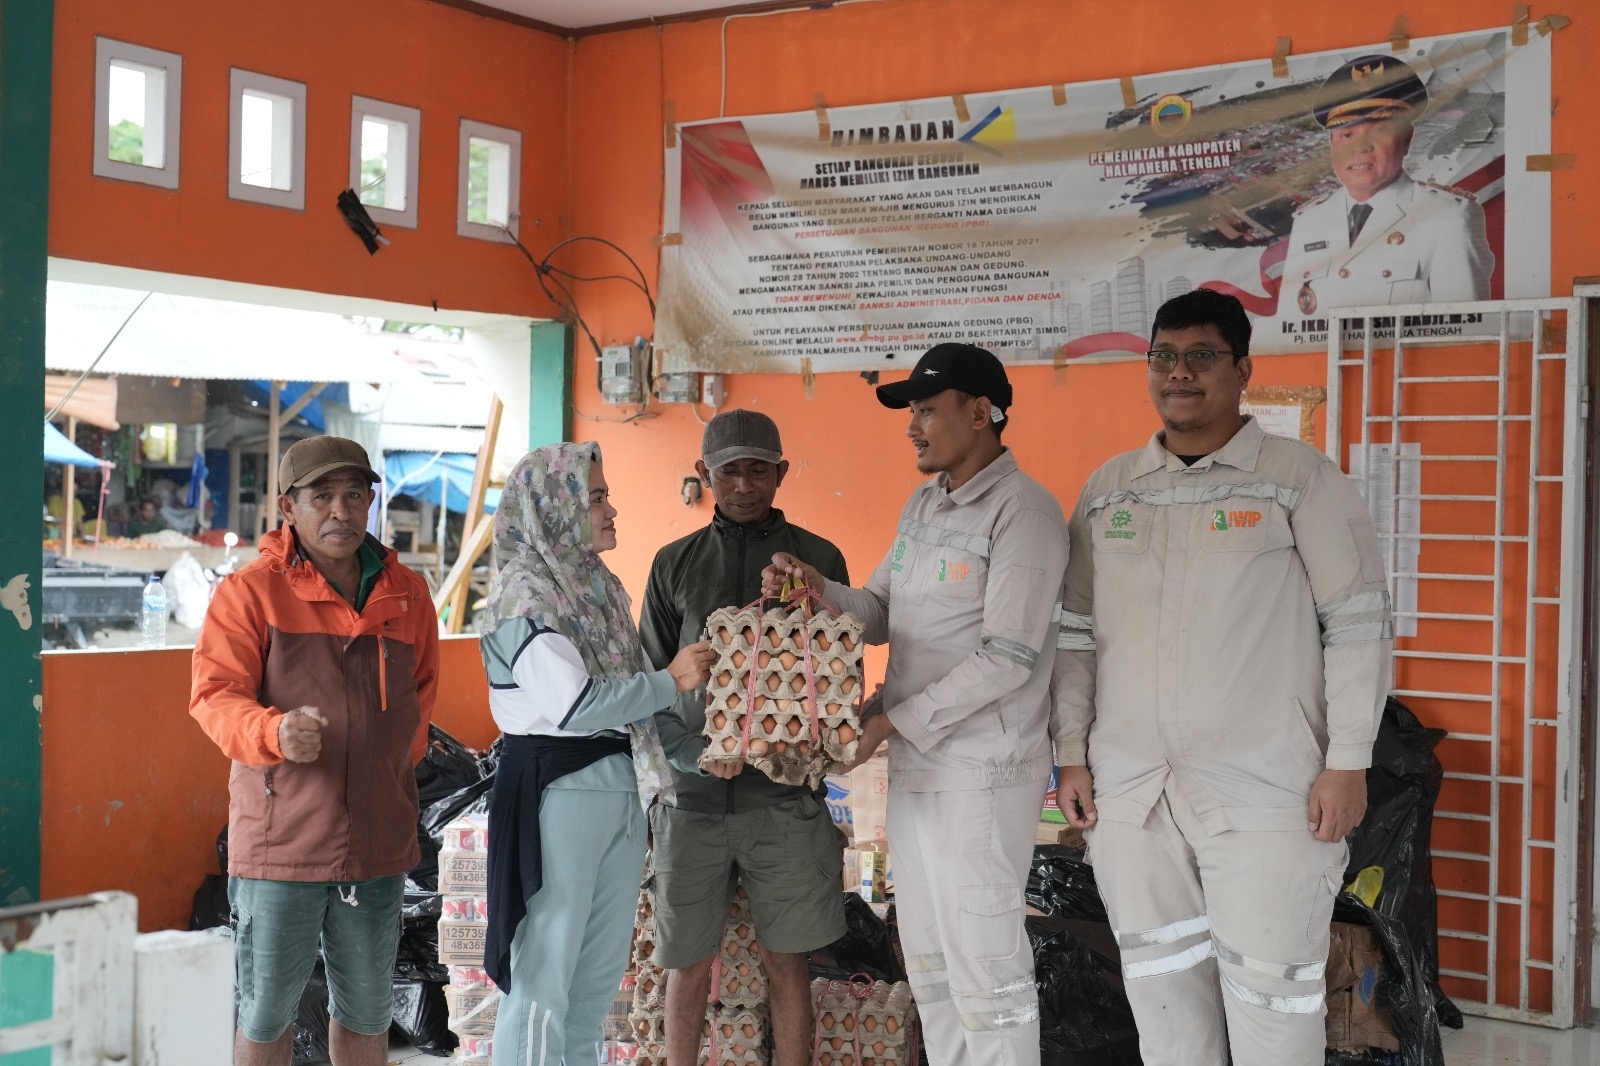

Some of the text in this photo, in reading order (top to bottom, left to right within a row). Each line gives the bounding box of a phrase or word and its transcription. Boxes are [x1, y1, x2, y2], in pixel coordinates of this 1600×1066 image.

[830, 119, 955, 148] HIMBAUAN
[815, 151, 965, 175] SETIAP BANGUNAN GEDUNG
[1090, 138, 1241, 165] PEMERINTAH KABUPATEN
[800, 162, 980, 190] HARUS MEMILIKI IZIN BANGUNAN
[1105, 154, 1230, 178] HALMAHERA TENGAH
[738, 180, 1053, 211] KEPADA SELURUH MASYARAKAT YANG AKAN DAN TELAH MEMBANGUN
[748, 193, 1041, 221] BELUM MEMILIKI IZIN MAKA WAJIB MENGURUS IZIN MENDIRIKAN
[752, 205, 1037, 231] BANGUNAN YANG SEKARANG TELAH BERGANTI NAMA DENGAN
[795, 228, 856, 239] PERSETUJUAN
[858, 224, 911, 236] BANGUNAN
[916, 221, 959, 230] GEDUNG
[748, 238, 1039, 263] SEBAGAIMANA PERATURAN PEMERINTAH NOMOR 16 TAHUN 2021
[771, 250, 1011, 272] TENTANG PERATURAN PELAKSANA UNDANG-UNDANG
[739, 270, 1049, 295] MENGAMANATKAN SANKSI JIKA PEMILIK DAN PENGGUNA BANGUNAN
[759, 260, 1027, 283] NOMOR 28 TAHUN 2002 TENTANG BANGUNAN DAN GEDUNG.
[732, 308, 753, 316] ATAU
[755, 305, 816, 315] PERSYARATAN
[818, 303, 856, 312] DIKENAI
[858, 302, 893, 310] SANKSI
[1003, 294, 1024, 303] DAN
[1026, 292, 1061, 301] DENDA
[775, 284, 1007, 304] TIDAK MEMENUHI KEWAJIBAN PEMENUHAN FUNGSI
[753, 316, 1034, 336] UNTUK PELAYANAN PERSETUJUAN BANGUNAN GEDUNG (PBG)
[762, 338, 793, 347] ONLINE
[796, 336, 833, 345] MELALUI
[927, 330, 952, 339] ATAU
[955, 330, 965, 338] DI
[968, 327, 1032, 338] SEKERTARIAT
[1035, 326, 1067, 335] SIMBG
[1416, 327, 1462, 337] TENGAH
[753, 349, 803, 358] KABUPATEN
[806, 346, 860, 356] HALMAHERA
[863, 345, 901, 353] TENGAH
[903, 343, 932, 352] DINAS
[445, 927, 487, 938] 125739
